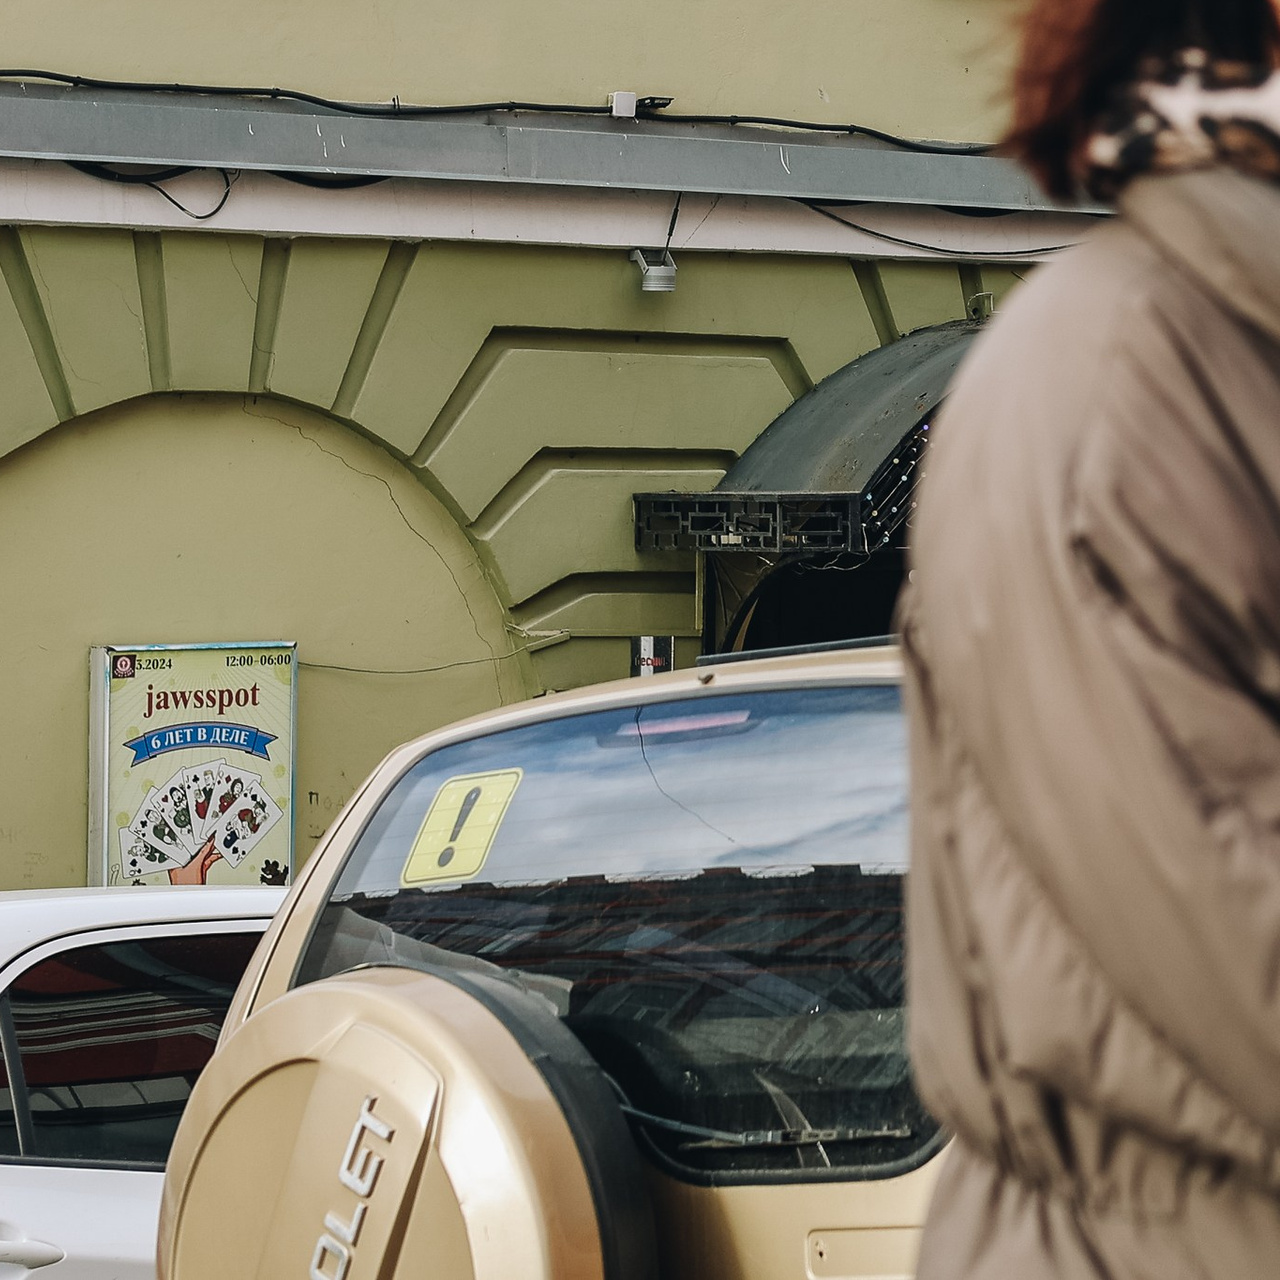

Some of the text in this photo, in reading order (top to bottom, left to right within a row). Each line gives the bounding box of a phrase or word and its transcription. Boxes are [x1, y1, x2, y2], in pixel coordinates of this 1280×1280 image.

[143, 682, 260, 718] jawsspot
[151, 727, 250, 749] 6 ЛЕТ В ДЕЛЕ
